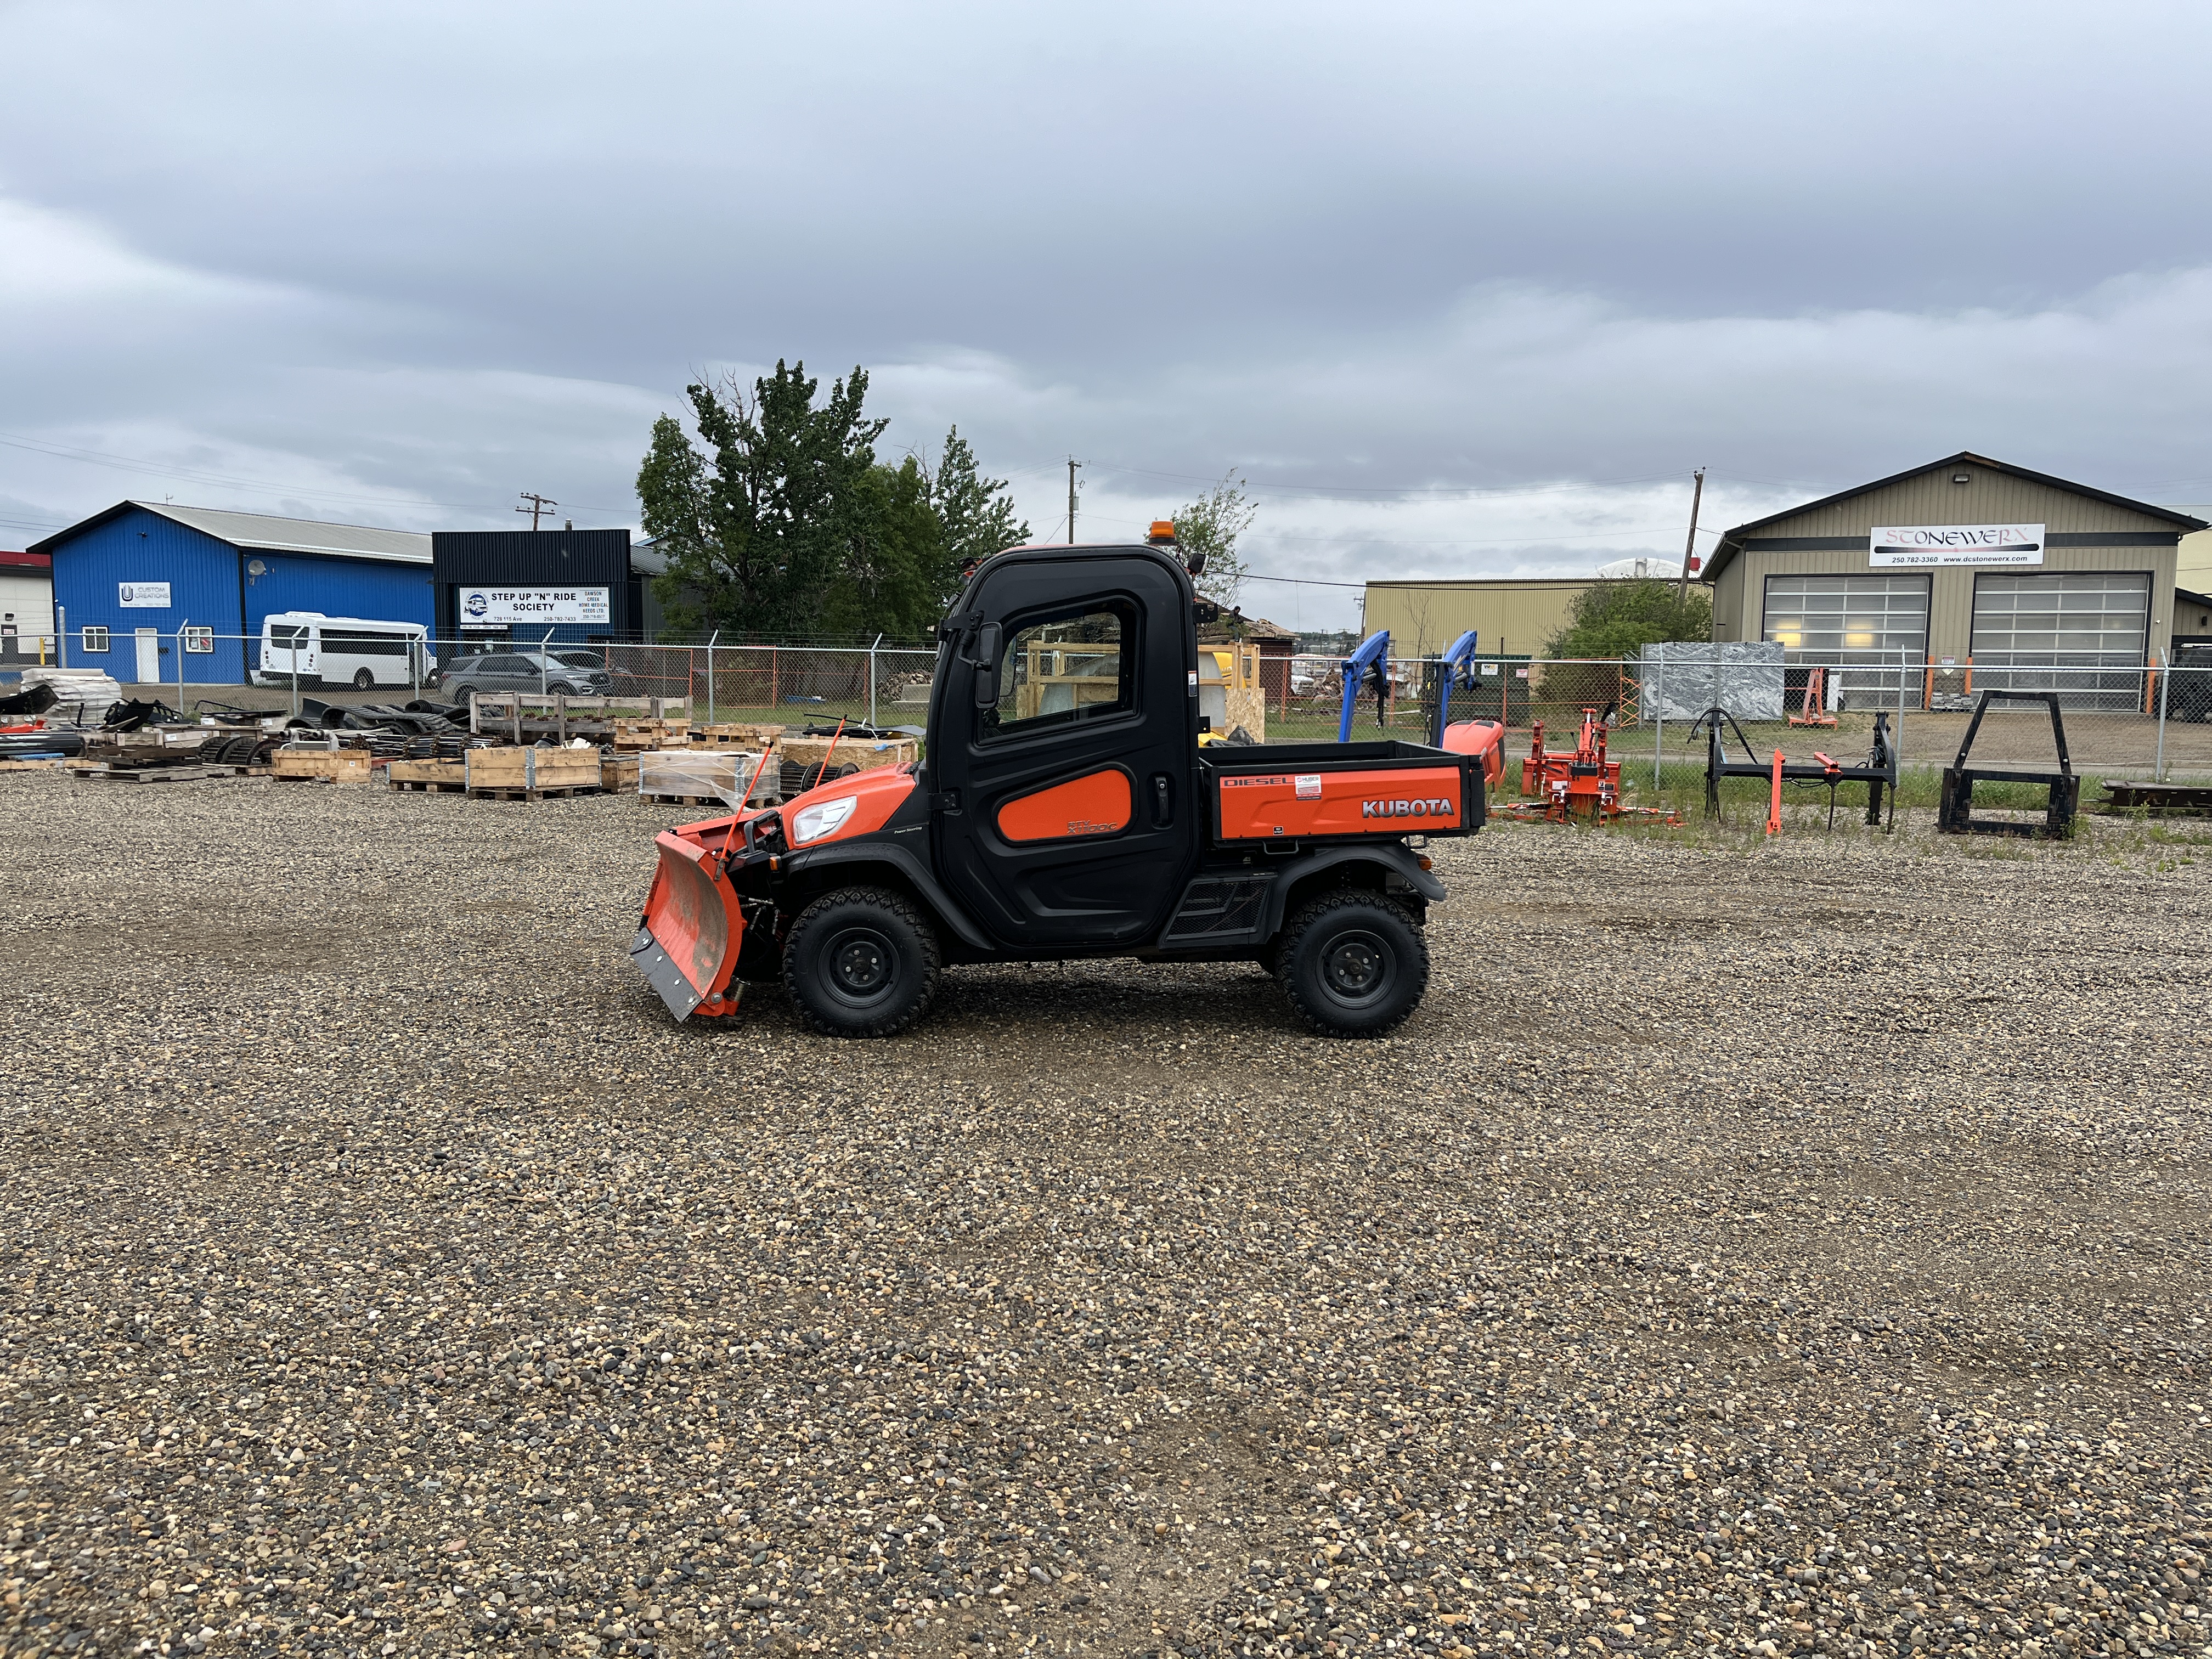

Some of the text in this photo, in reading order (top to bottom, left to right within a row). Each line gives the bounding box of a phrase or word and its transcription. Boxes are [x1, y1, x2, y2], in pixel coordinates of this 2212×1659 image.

[1886, 527, 2029, 545] STONEWERX
[1224, 777, 1295, 787] DIESEL
[1363, 798, 1454, 818] KUBOTA
[1066, 822, 1118, 834] X1100C
